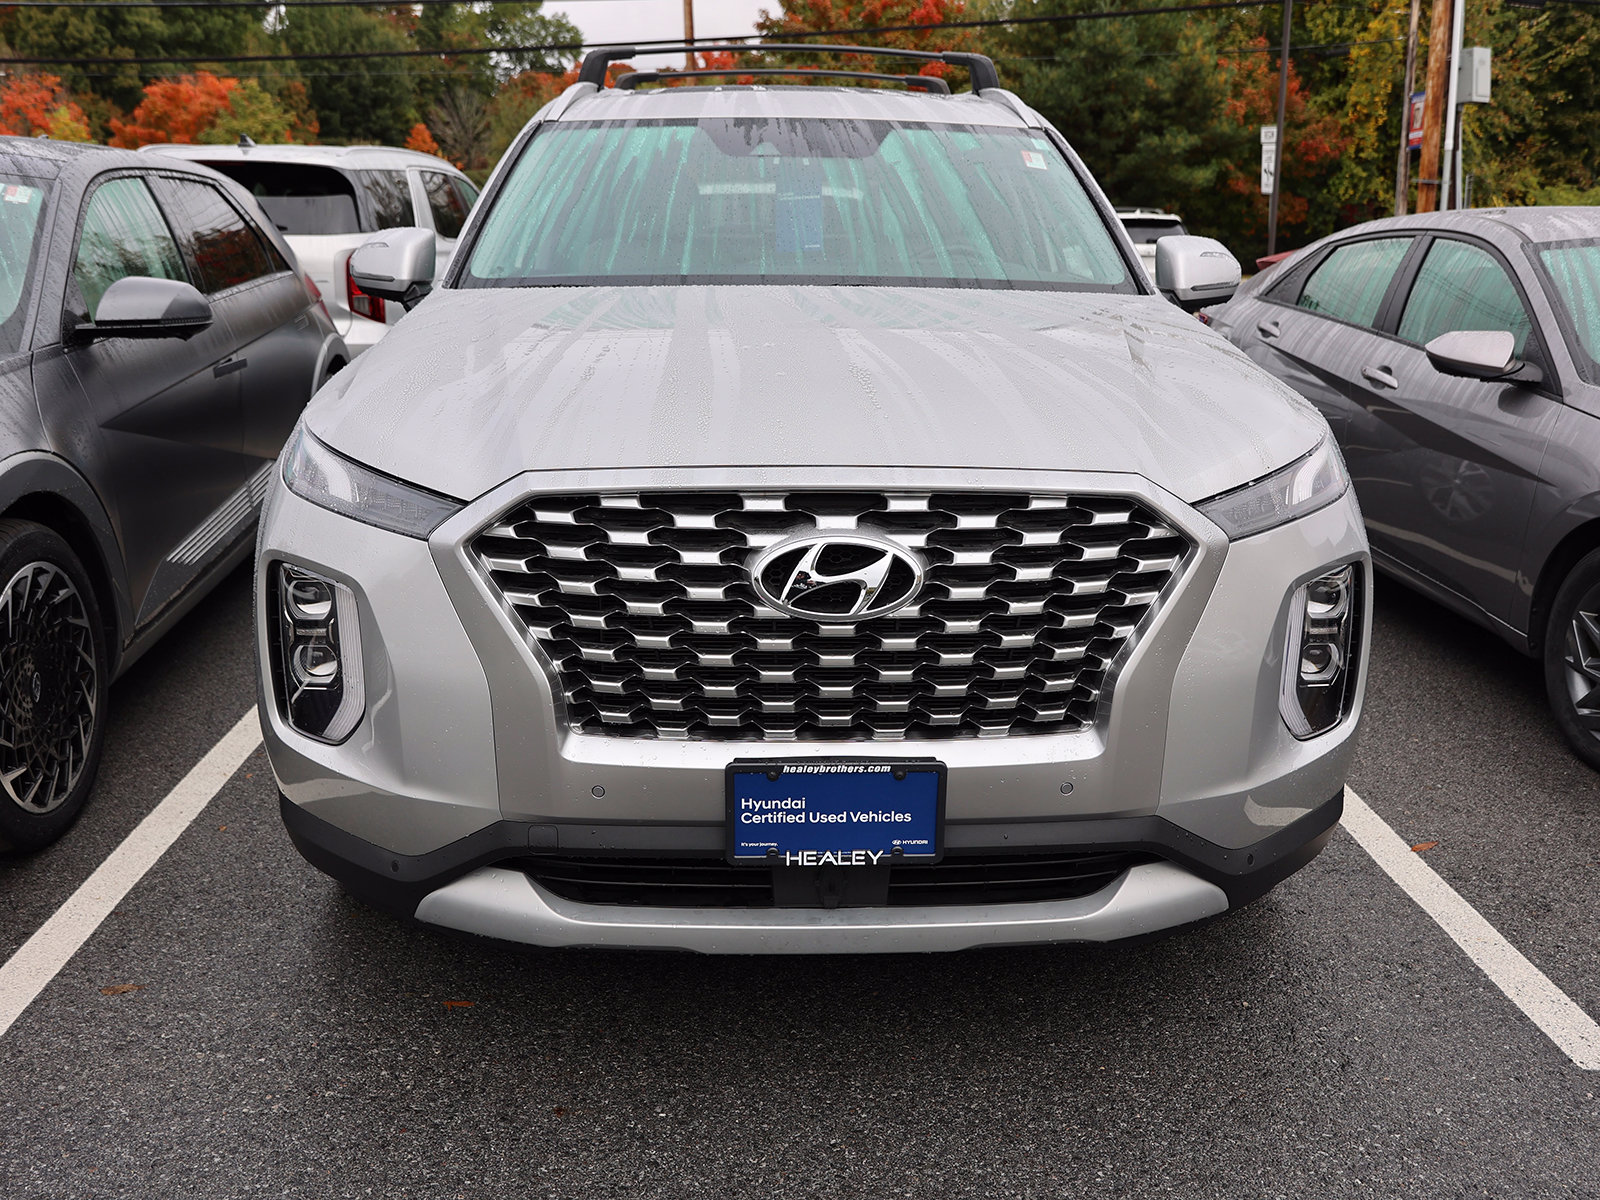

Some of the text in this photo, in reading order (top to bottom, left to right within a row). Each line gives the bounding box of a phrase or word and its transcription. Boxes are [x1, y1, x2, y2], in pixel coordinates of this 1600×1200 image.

[782, 764, 891, 774] healeybrothers.com
[741, 797, 806, 812] Hyundai
[740, 810, 912, 825] Certified Used Vehicles
[786, 850, 884, 866] HEALEY
